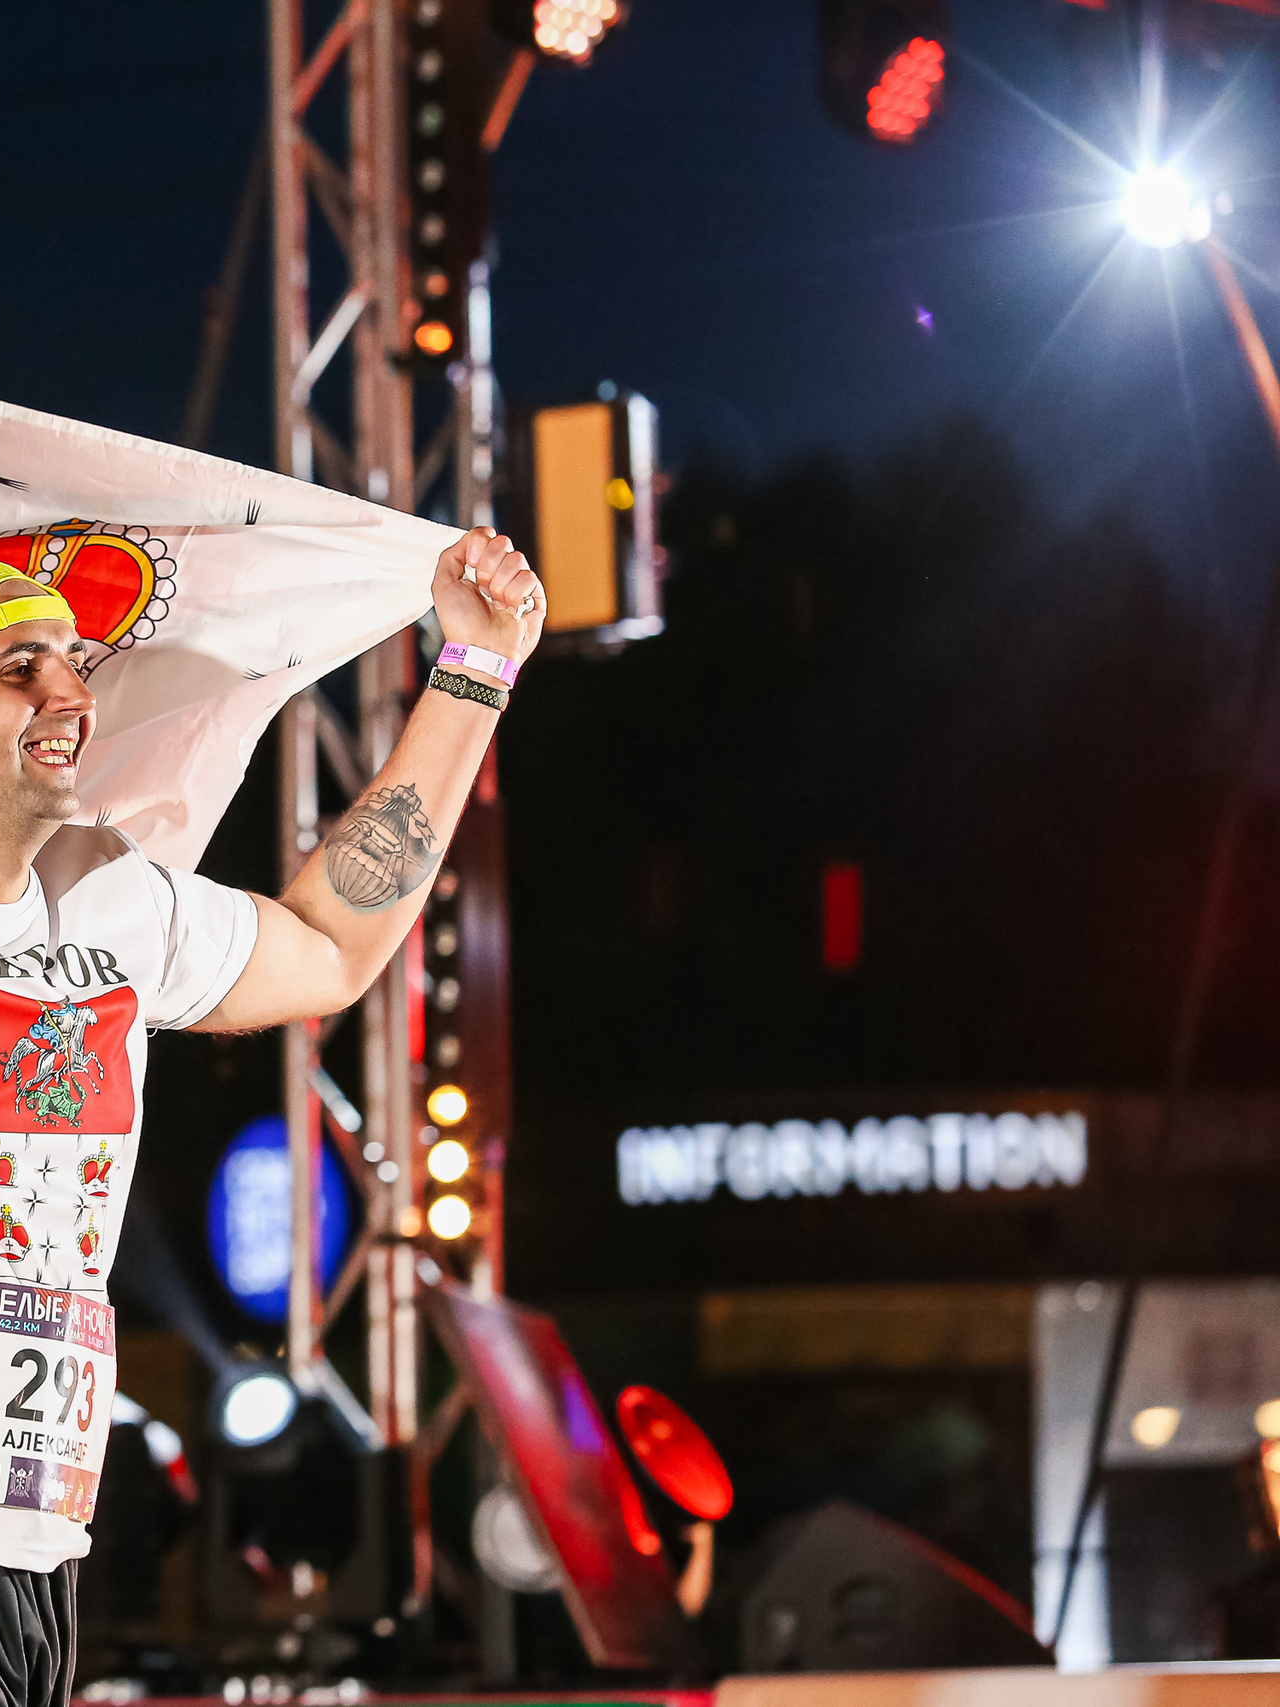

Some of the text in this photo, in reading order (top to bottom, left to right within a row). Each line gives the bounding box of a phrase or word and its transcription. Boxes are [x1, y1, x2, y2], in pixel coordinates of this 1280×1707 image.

[617, 1110, 1088, 1206] INFORMATION
[23, 1322, 40, 1334] КМ
[4, 1348, 96, 1432] 293
